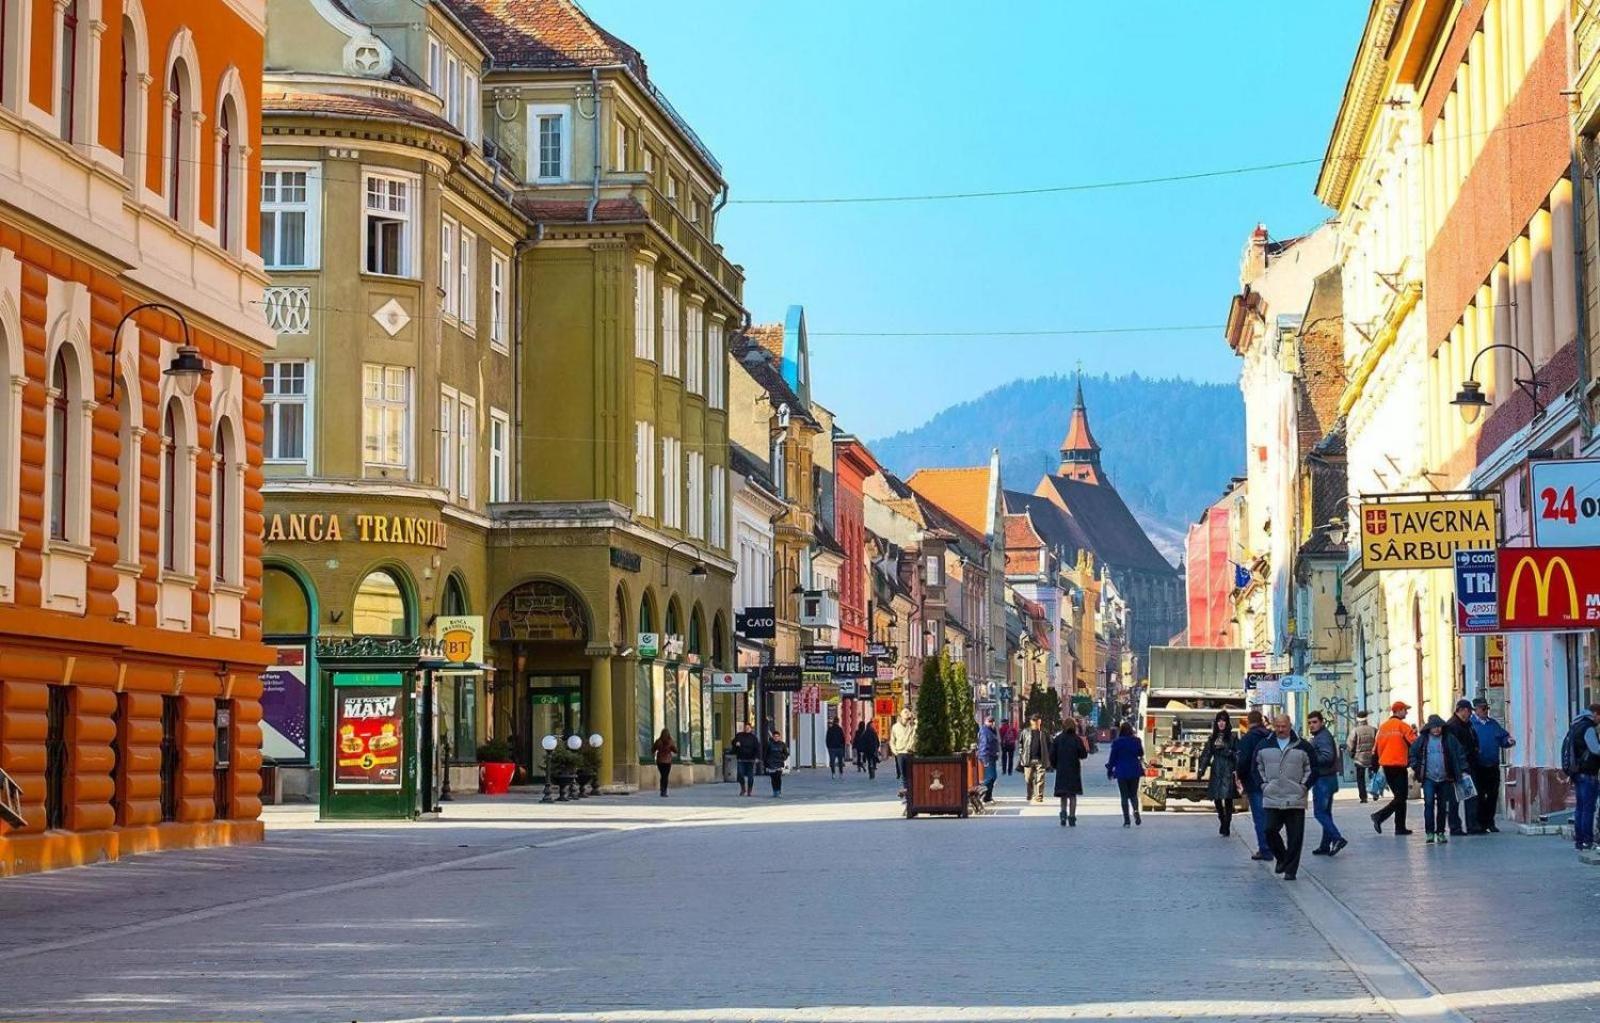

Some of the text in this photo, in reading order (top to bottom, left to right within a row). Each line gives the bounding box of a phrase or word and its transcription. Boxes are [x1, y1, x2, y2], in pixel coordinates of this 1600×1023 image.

[1540, 485, 1578, 525] 24
[1390, 509, 1489, 534] TAVERNA
[746, 619, 774, 627] CATO
[449, 641, 467, 654] BT
[343, 696, 397, 719] MAN!
